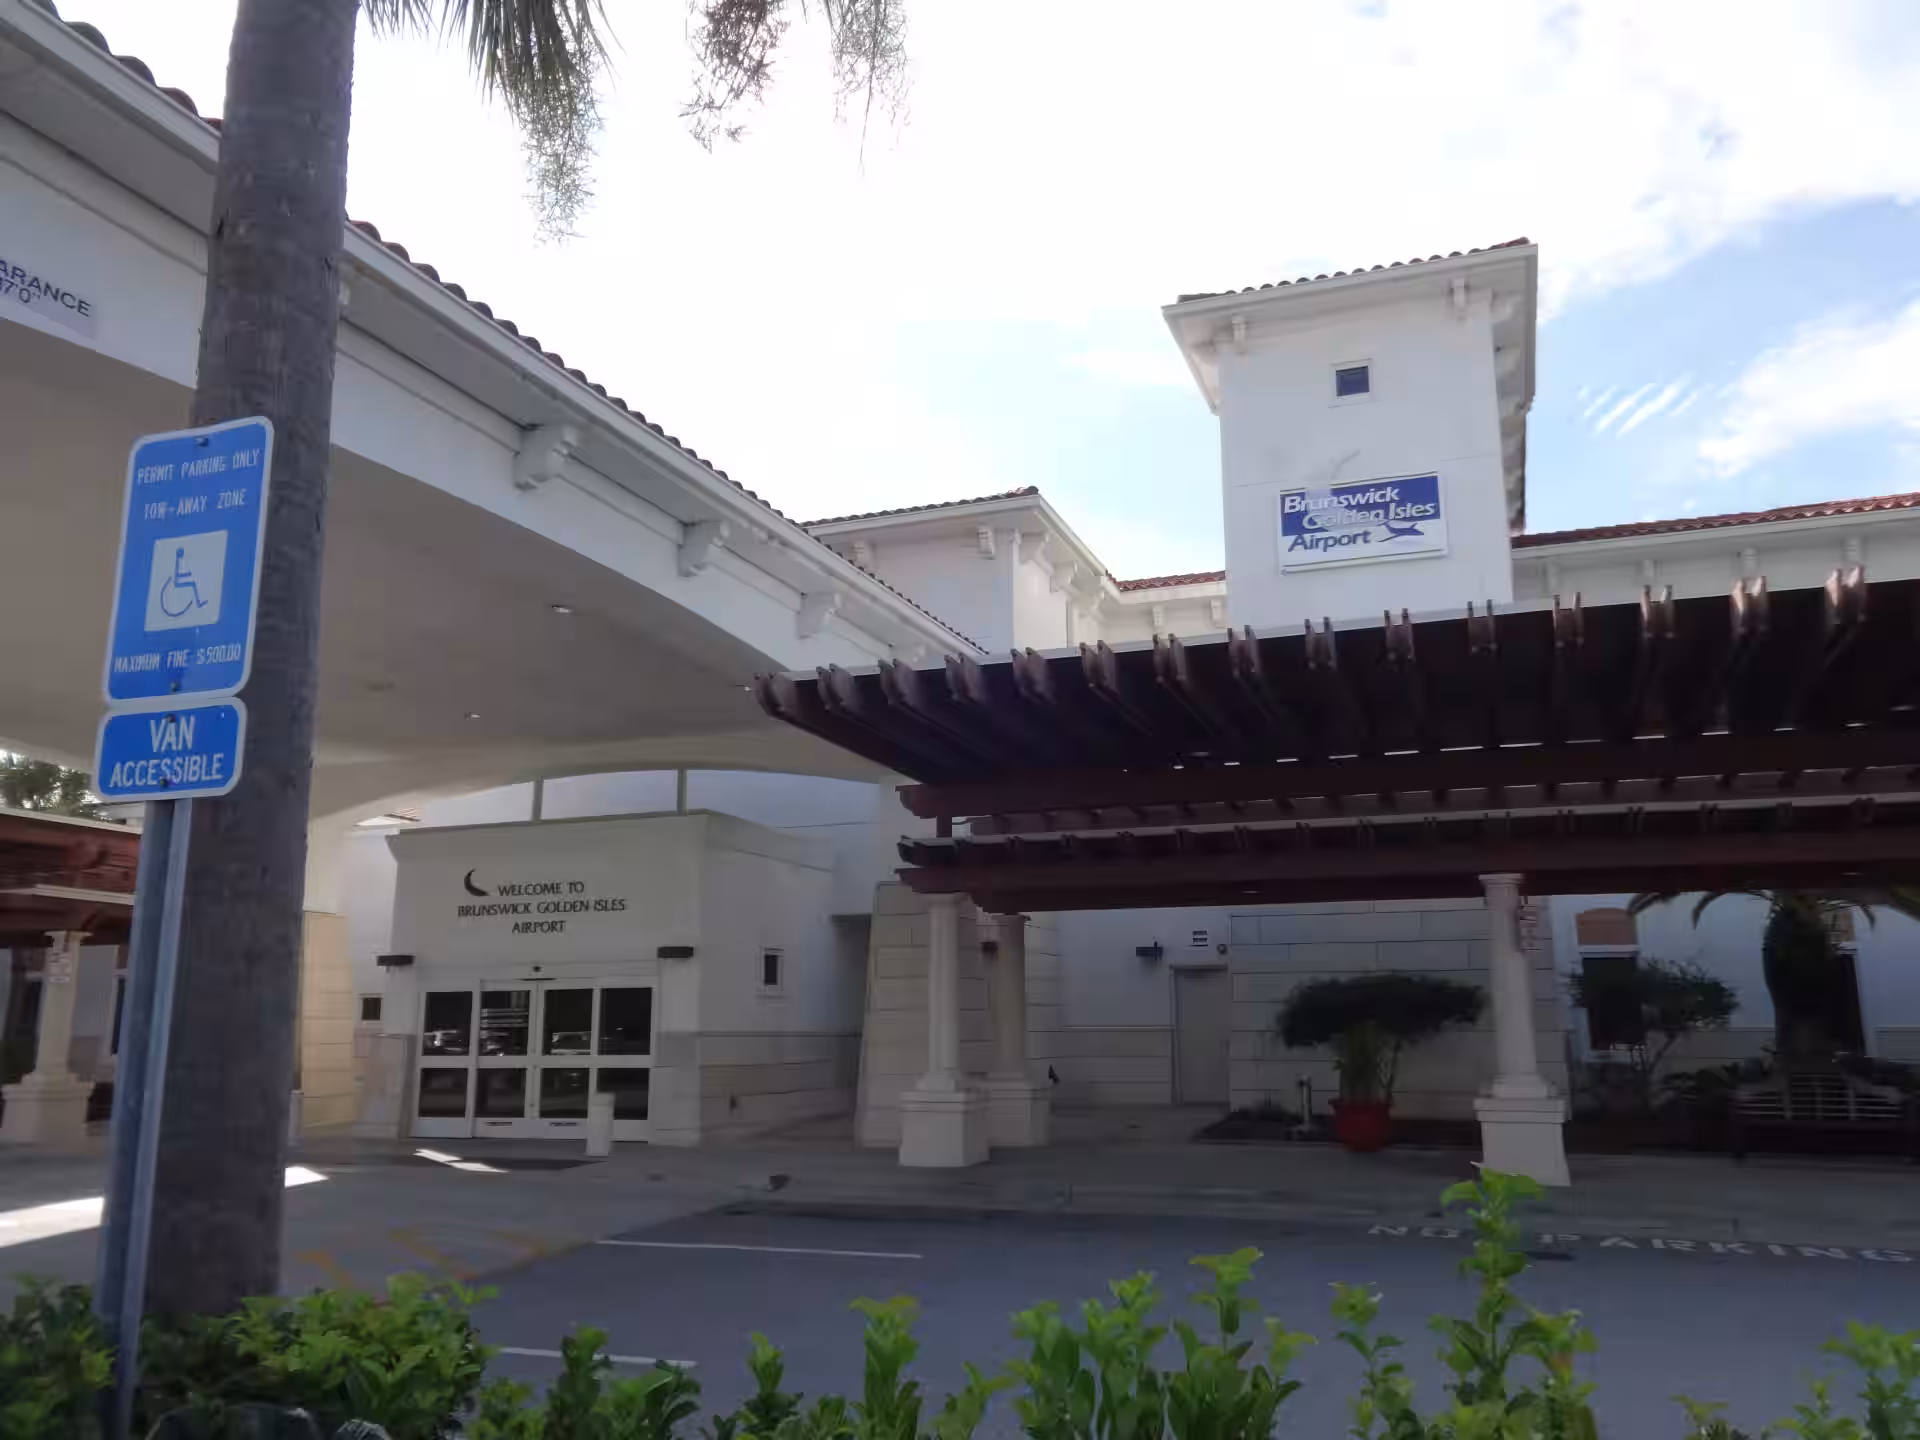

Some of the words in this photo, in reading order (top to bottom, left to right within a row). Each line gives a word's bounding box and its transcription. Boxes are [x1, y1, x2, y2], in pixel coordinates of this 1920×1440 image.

[137, 463, 174, 485] PERMIT
[181, 456, 226, 479] PARKING
[232, 448, 260, 469] ONLY
[144, 495, 207, 520] TOW-AWAY
[217, 488, 247, 508] ZONE
[1284, 486, 1400, 513] Brunswick
[1302, 508, 1385, 530] Golden
[1389, 502, 1436, 520] Isles
[1288, 529, 1372, 552] Airport
[113, 653, 160, 674] MAXIMUM
[167, 648, 191, 669] FINE
[150, 715, 195, 752] VAN
[109, 753, 224, 788] ACCESSIBLE
[498, 882, 562, 897] WELCOME
[568, 881, 585, 894] TO
[457, 903, 531, 918] BRUNSWICK
[537, 900, 590, 914] GOLDEN
[593, 898, 627, 912] ISLES
[511, 920, 567, 934] AIRPORT
